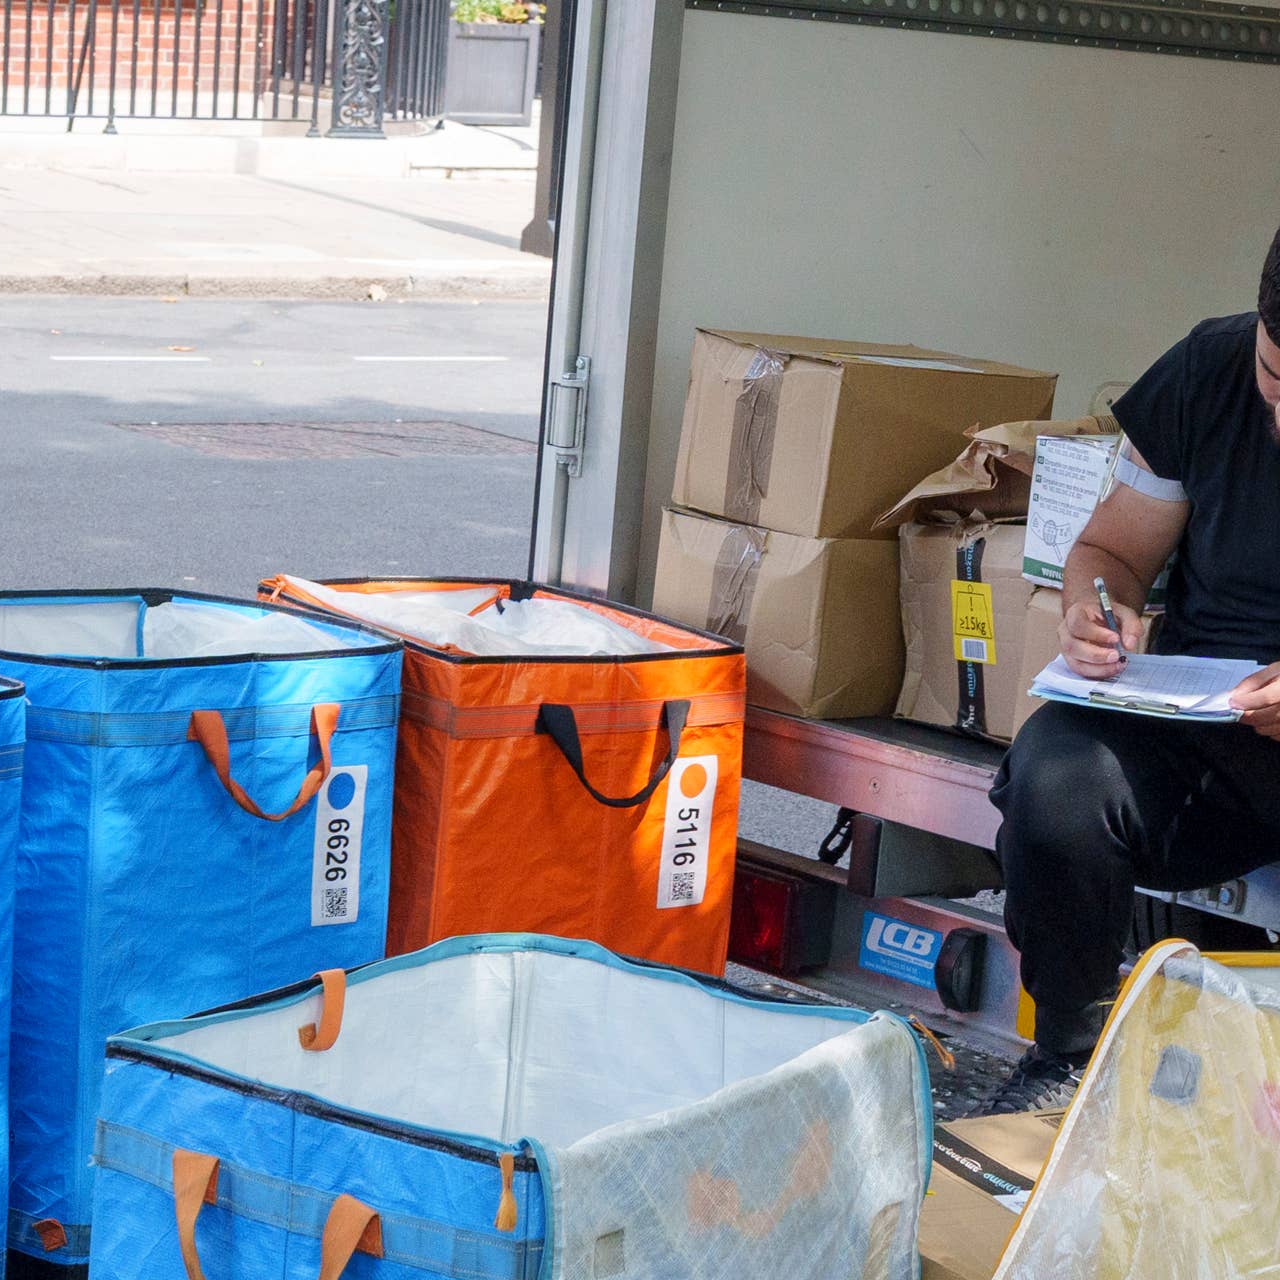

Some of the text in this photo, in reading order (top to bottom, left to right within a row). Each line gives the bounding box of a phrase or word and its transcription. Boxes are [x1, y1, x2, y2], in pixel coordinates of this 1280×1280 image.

[966, 543, 975, 580] mazon
[325, 818, 350, 882] 6626
[673, 807, 700, 867] 5116
[865, 917, 935, 962] LCB
